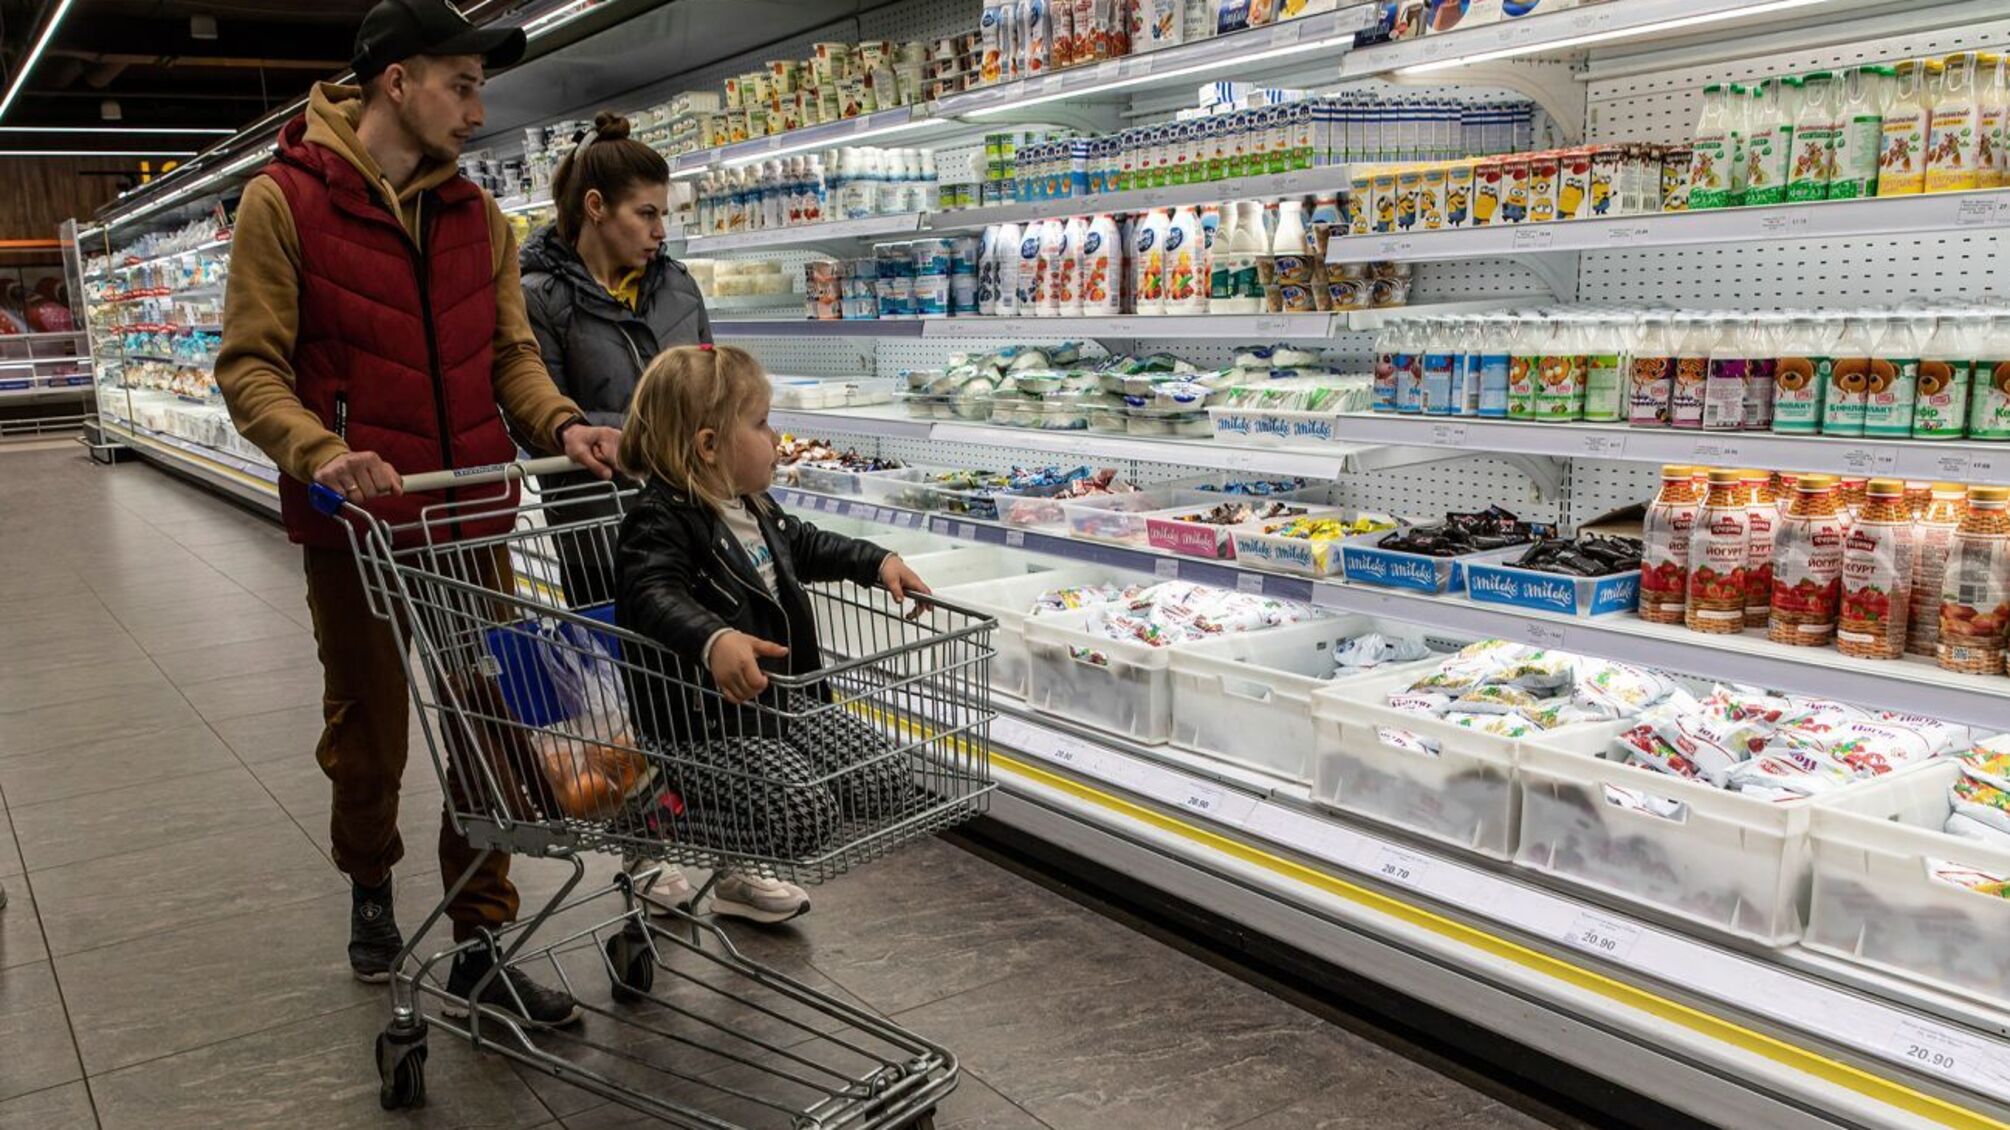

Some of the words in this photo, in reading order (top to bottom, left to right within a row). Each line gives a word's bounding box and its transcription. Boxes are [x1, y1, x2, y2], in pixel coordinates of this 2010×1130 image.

[1381, 863, 1410, 879] 20.70
[1581, 931, 1616, 951] 20.90
[1907, 1044, 1954, 1069] 20.90
